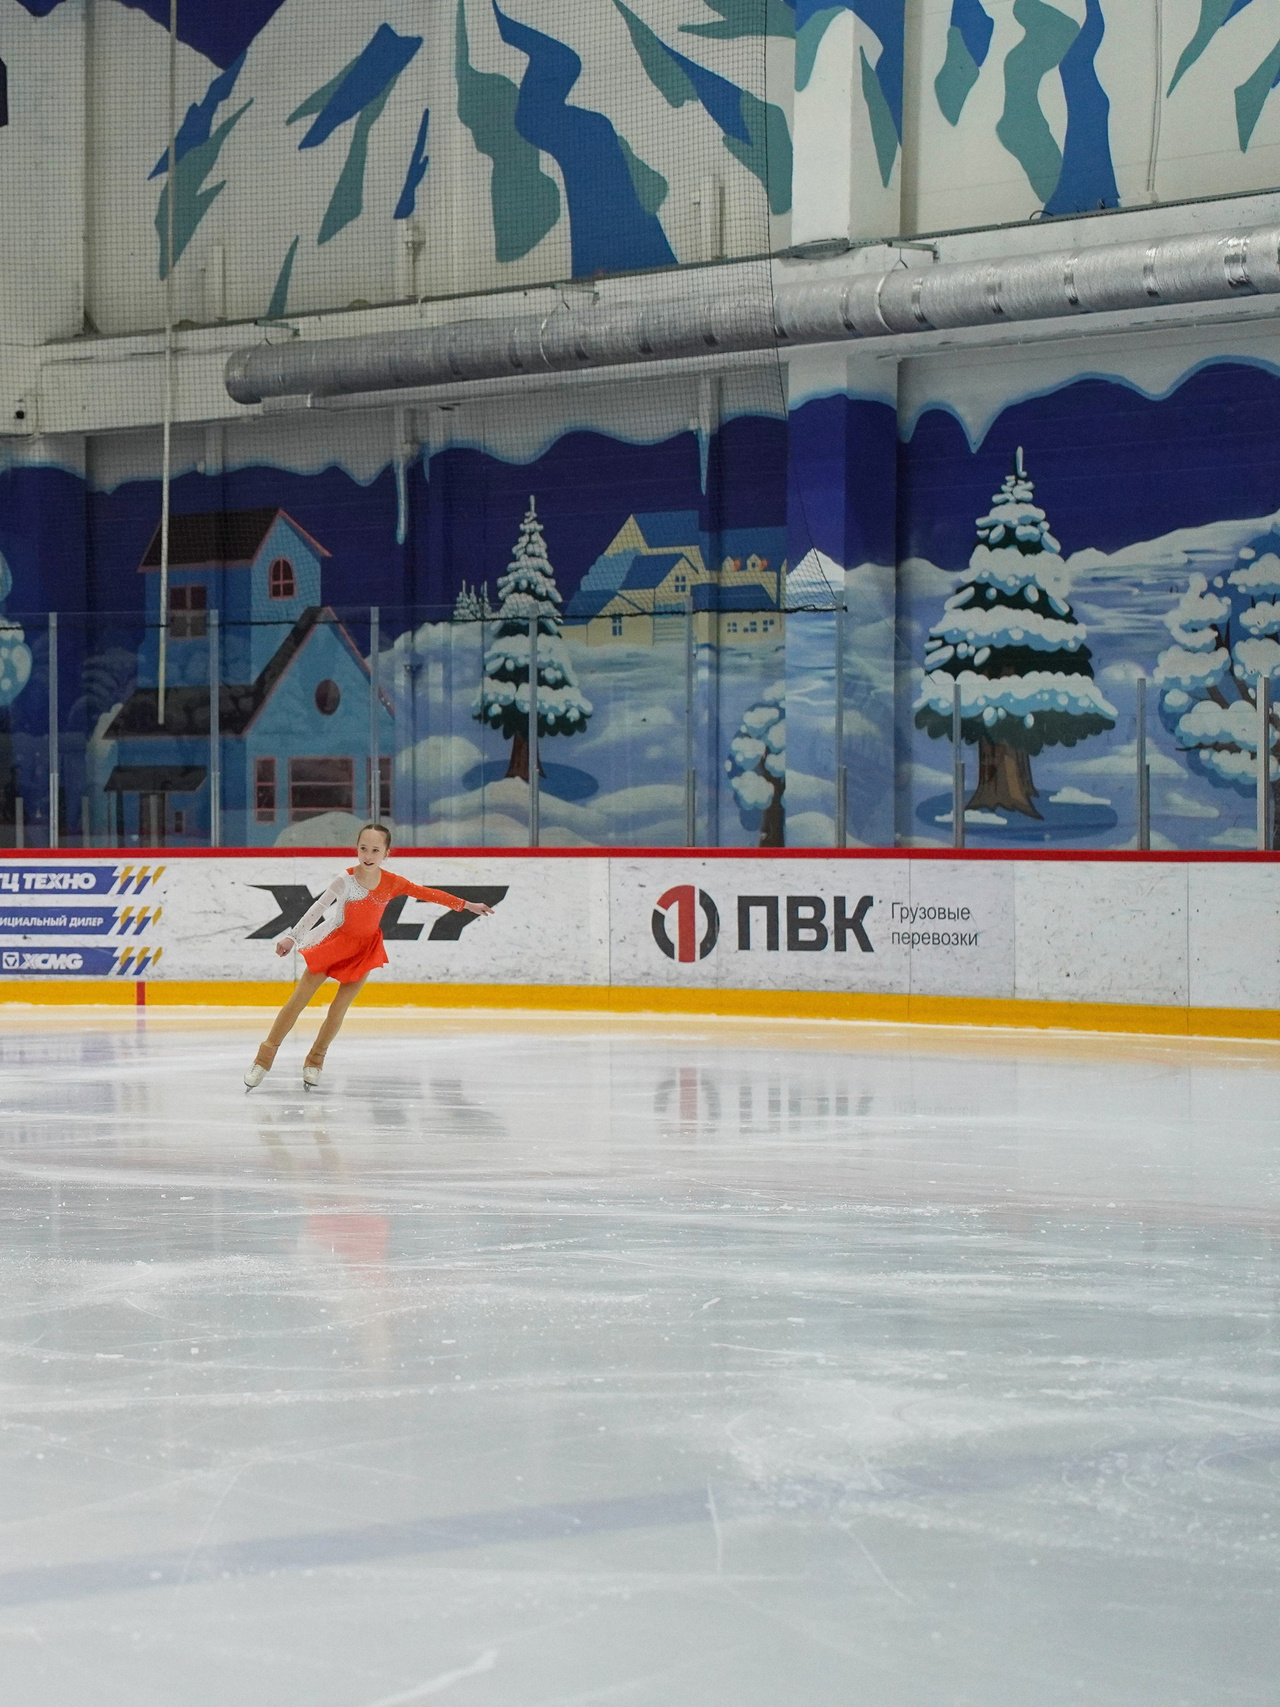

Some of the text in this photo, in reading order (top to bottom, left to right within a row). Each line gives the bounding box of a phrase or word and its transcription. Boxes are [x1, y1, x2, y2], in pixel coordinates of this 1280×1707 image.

[22, 872, 97, 890] ТЕХНО
[68, 917, 104, 928] ДИЛЕР
[891, 902, 971, 924] Грузовые
[737, 895, 874, 953] ПВК
[891, 930, 978, 950] перевозки
[20, 953, 84, 970] XCMG
